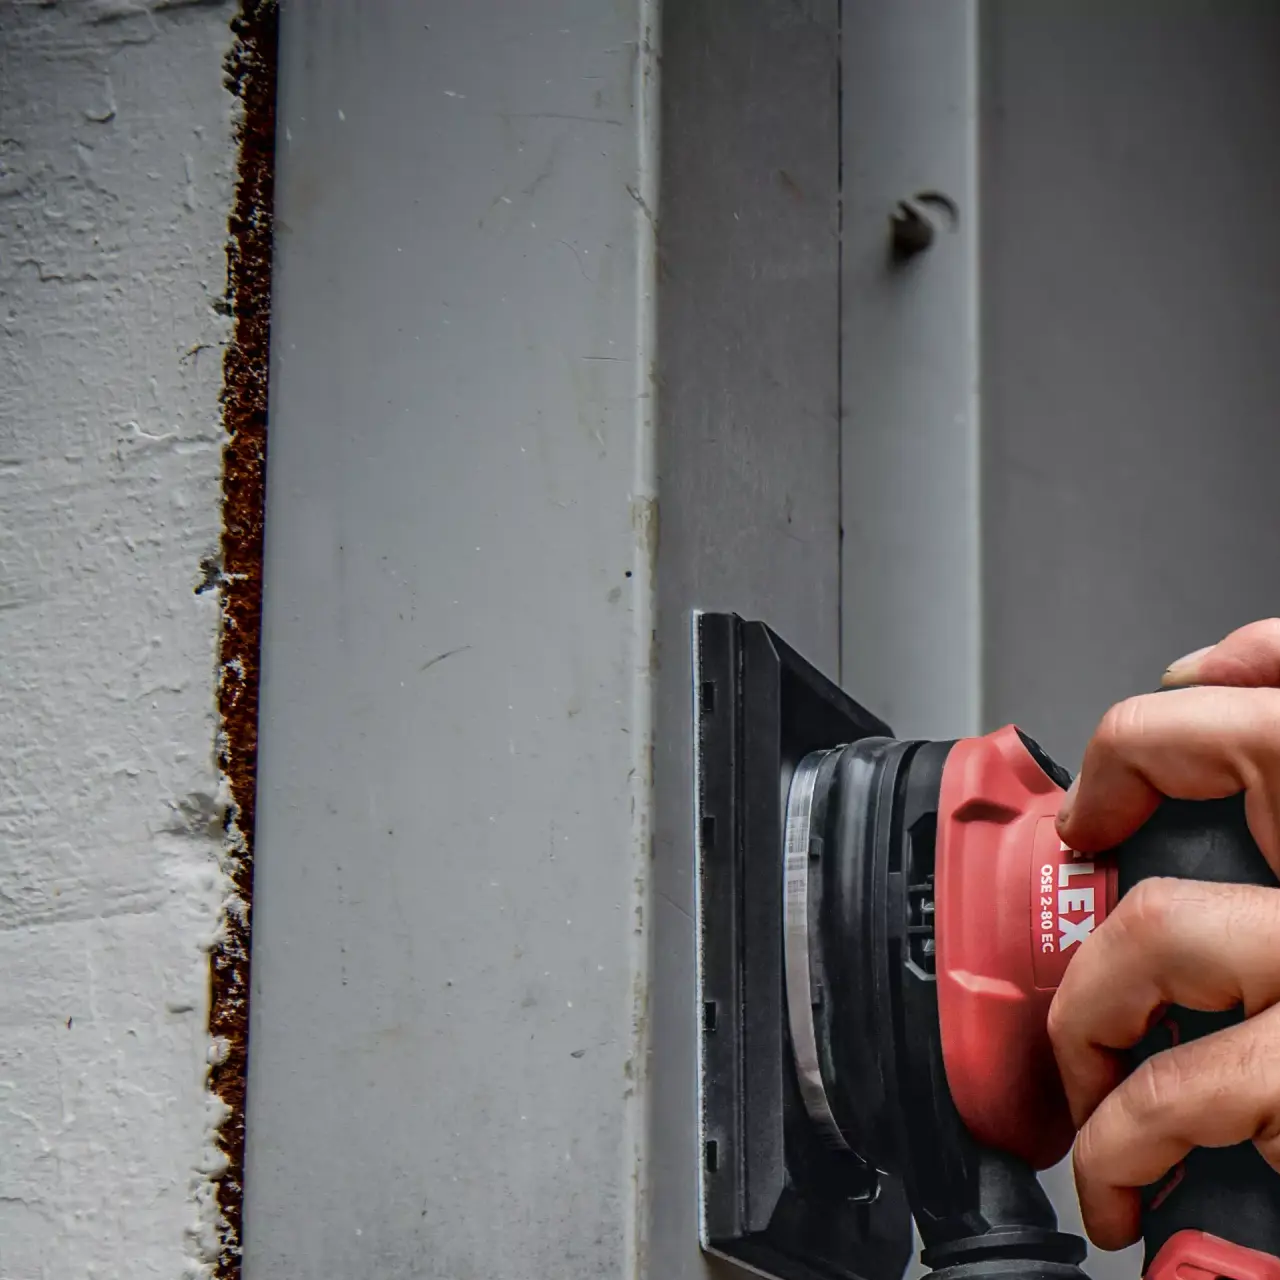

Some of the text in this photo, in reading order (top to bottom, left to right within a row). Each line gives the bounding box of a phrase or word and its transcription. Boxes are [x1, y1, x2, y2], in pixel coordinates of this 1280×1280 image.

[1040, 864, 1054, 953] OSE 2-80 EC
[1058, 840, 1095, 952] LEX
